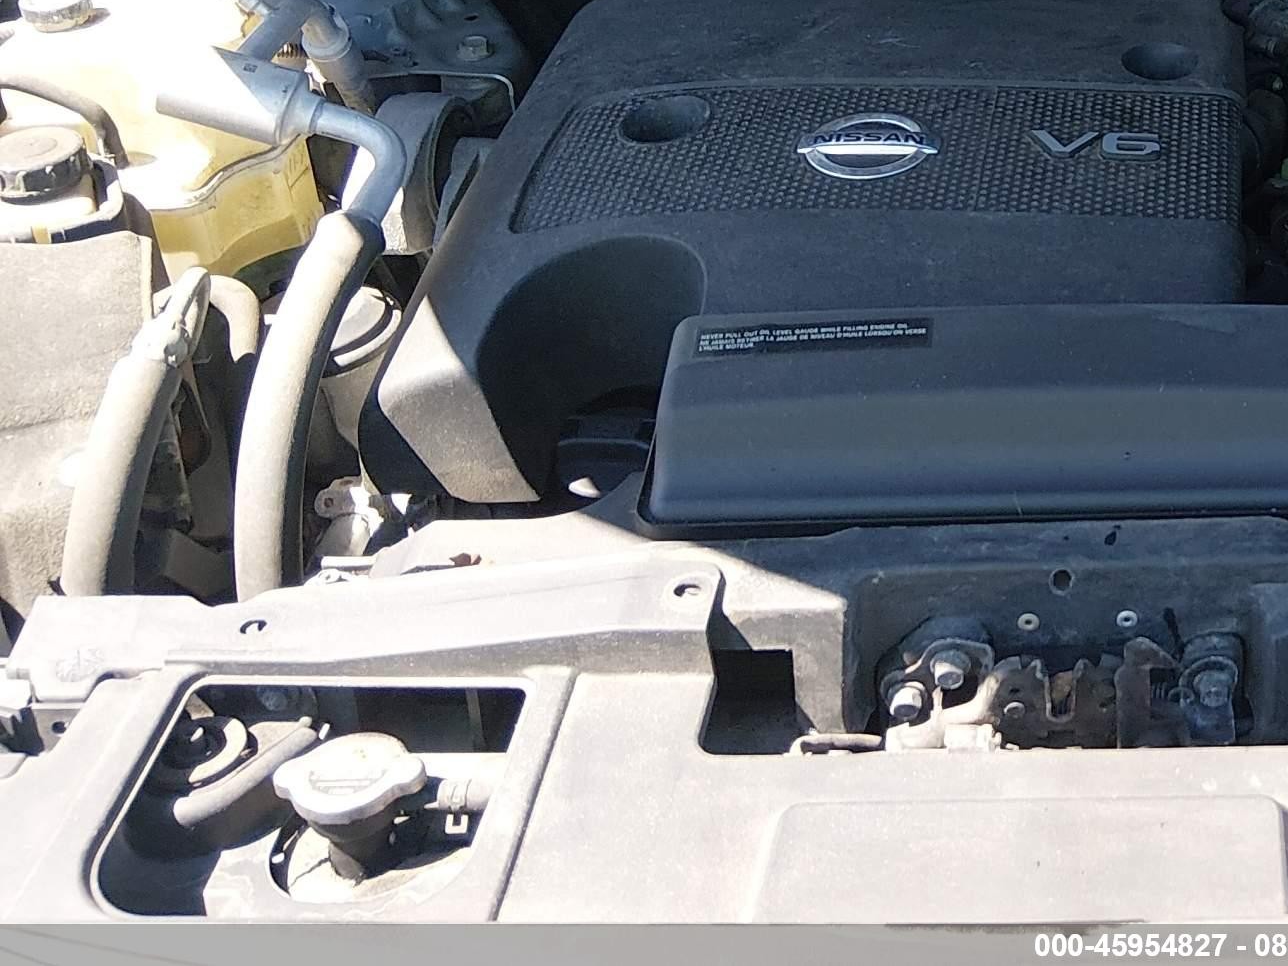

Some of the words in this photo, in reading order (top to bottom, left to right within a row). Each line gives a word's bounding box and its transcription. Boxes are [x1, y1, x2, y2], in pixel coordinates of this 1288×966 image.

[812, 130, 925, 145] NISSAN
[1029, 129, 1161, 161] V6
[772, 328, 793, 336] LEVEL
